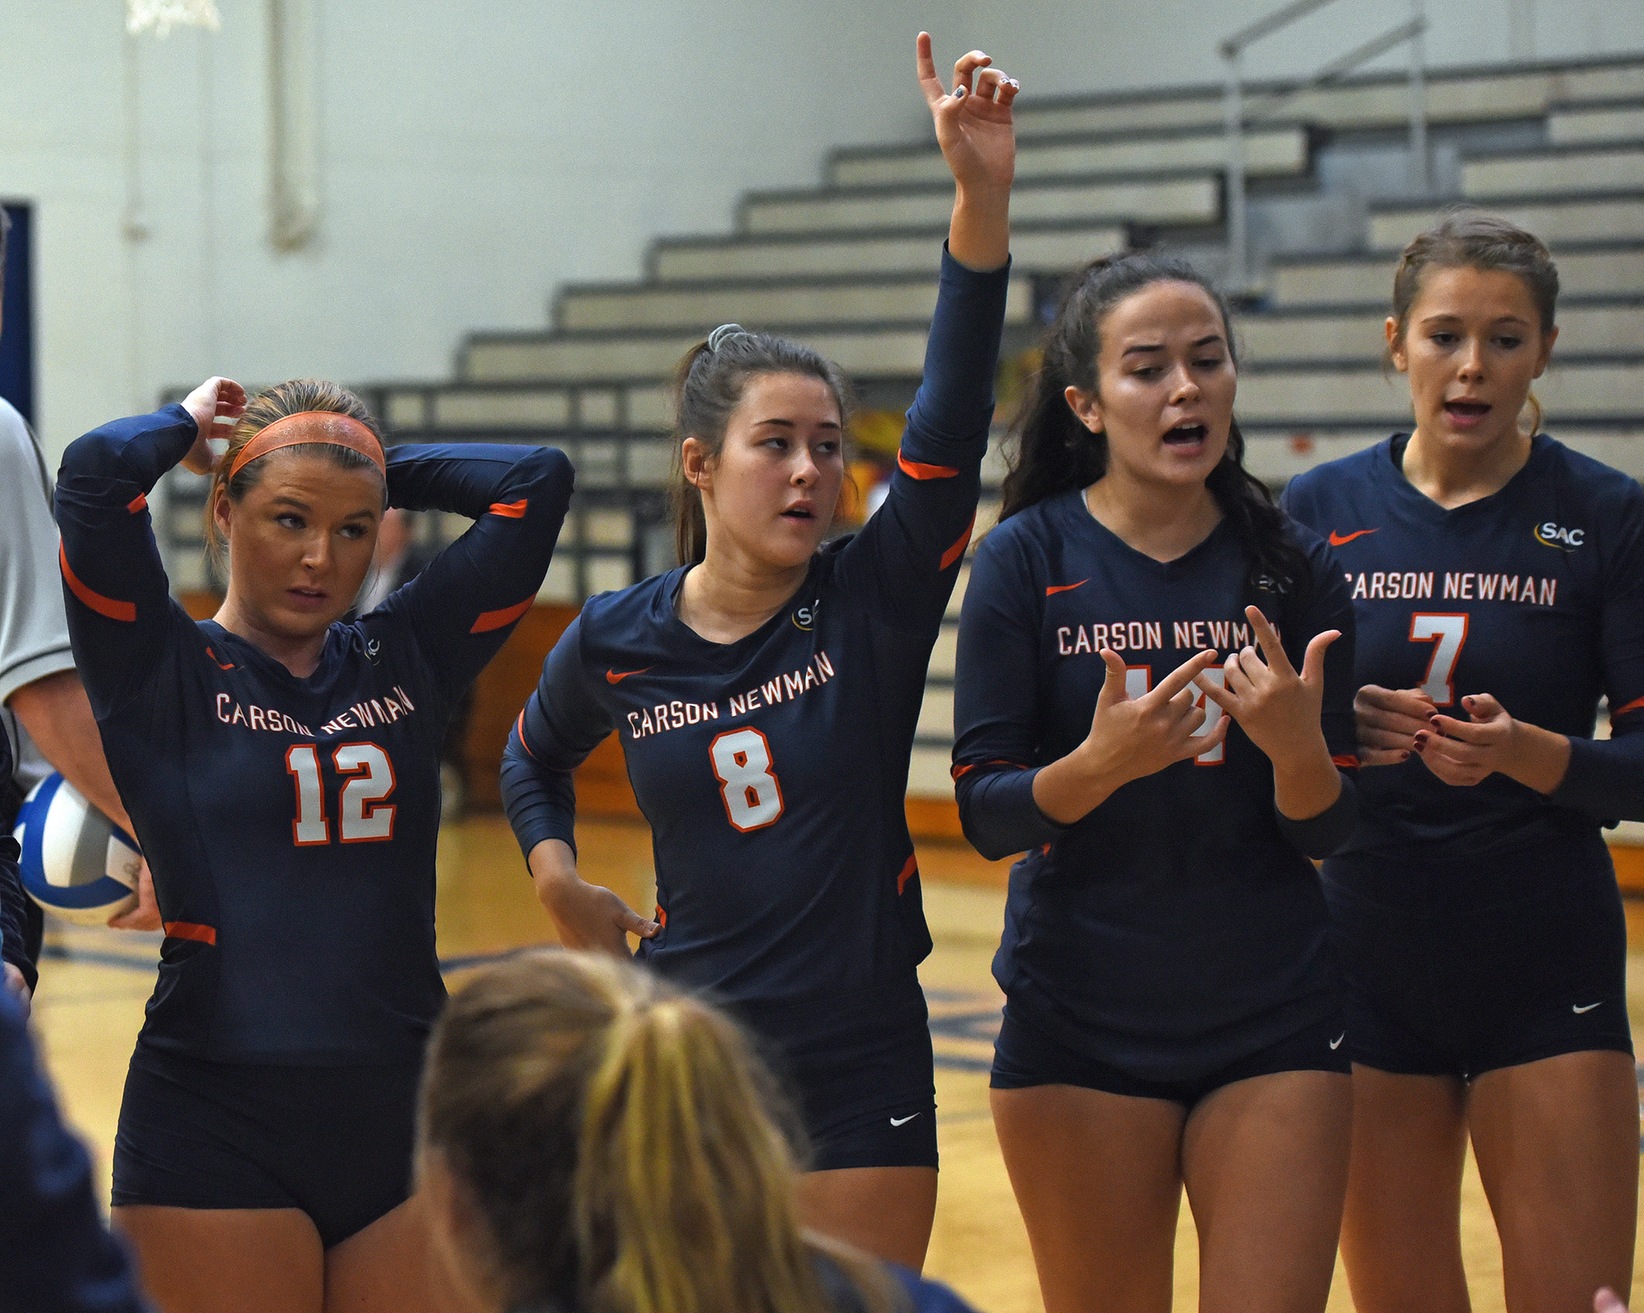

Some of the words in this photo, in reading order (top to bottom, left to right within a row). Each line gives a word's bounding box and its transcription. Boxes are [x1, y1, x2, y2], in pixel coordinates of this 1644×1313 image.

[1541, 522, 1586, 547] SAC
[1344, 571, 1434, 601] ARSON
[1443, 571, 1557, 606] NEWMAN
[1057, 621, 1162, 656] CARSON
[1173, 620, 1281, 651] NEWM
[1408, 612, 1469, 707] 7
[216, 693, 315, 737] CARSON
[321, 685, 415, 735] NEWMAN
[627, 700, 719, 739] CARSON
[729, 651, 835, 717] NEWMAN
[285, 741, 397, 847] 12
[708, 725, 785, 833] 8
